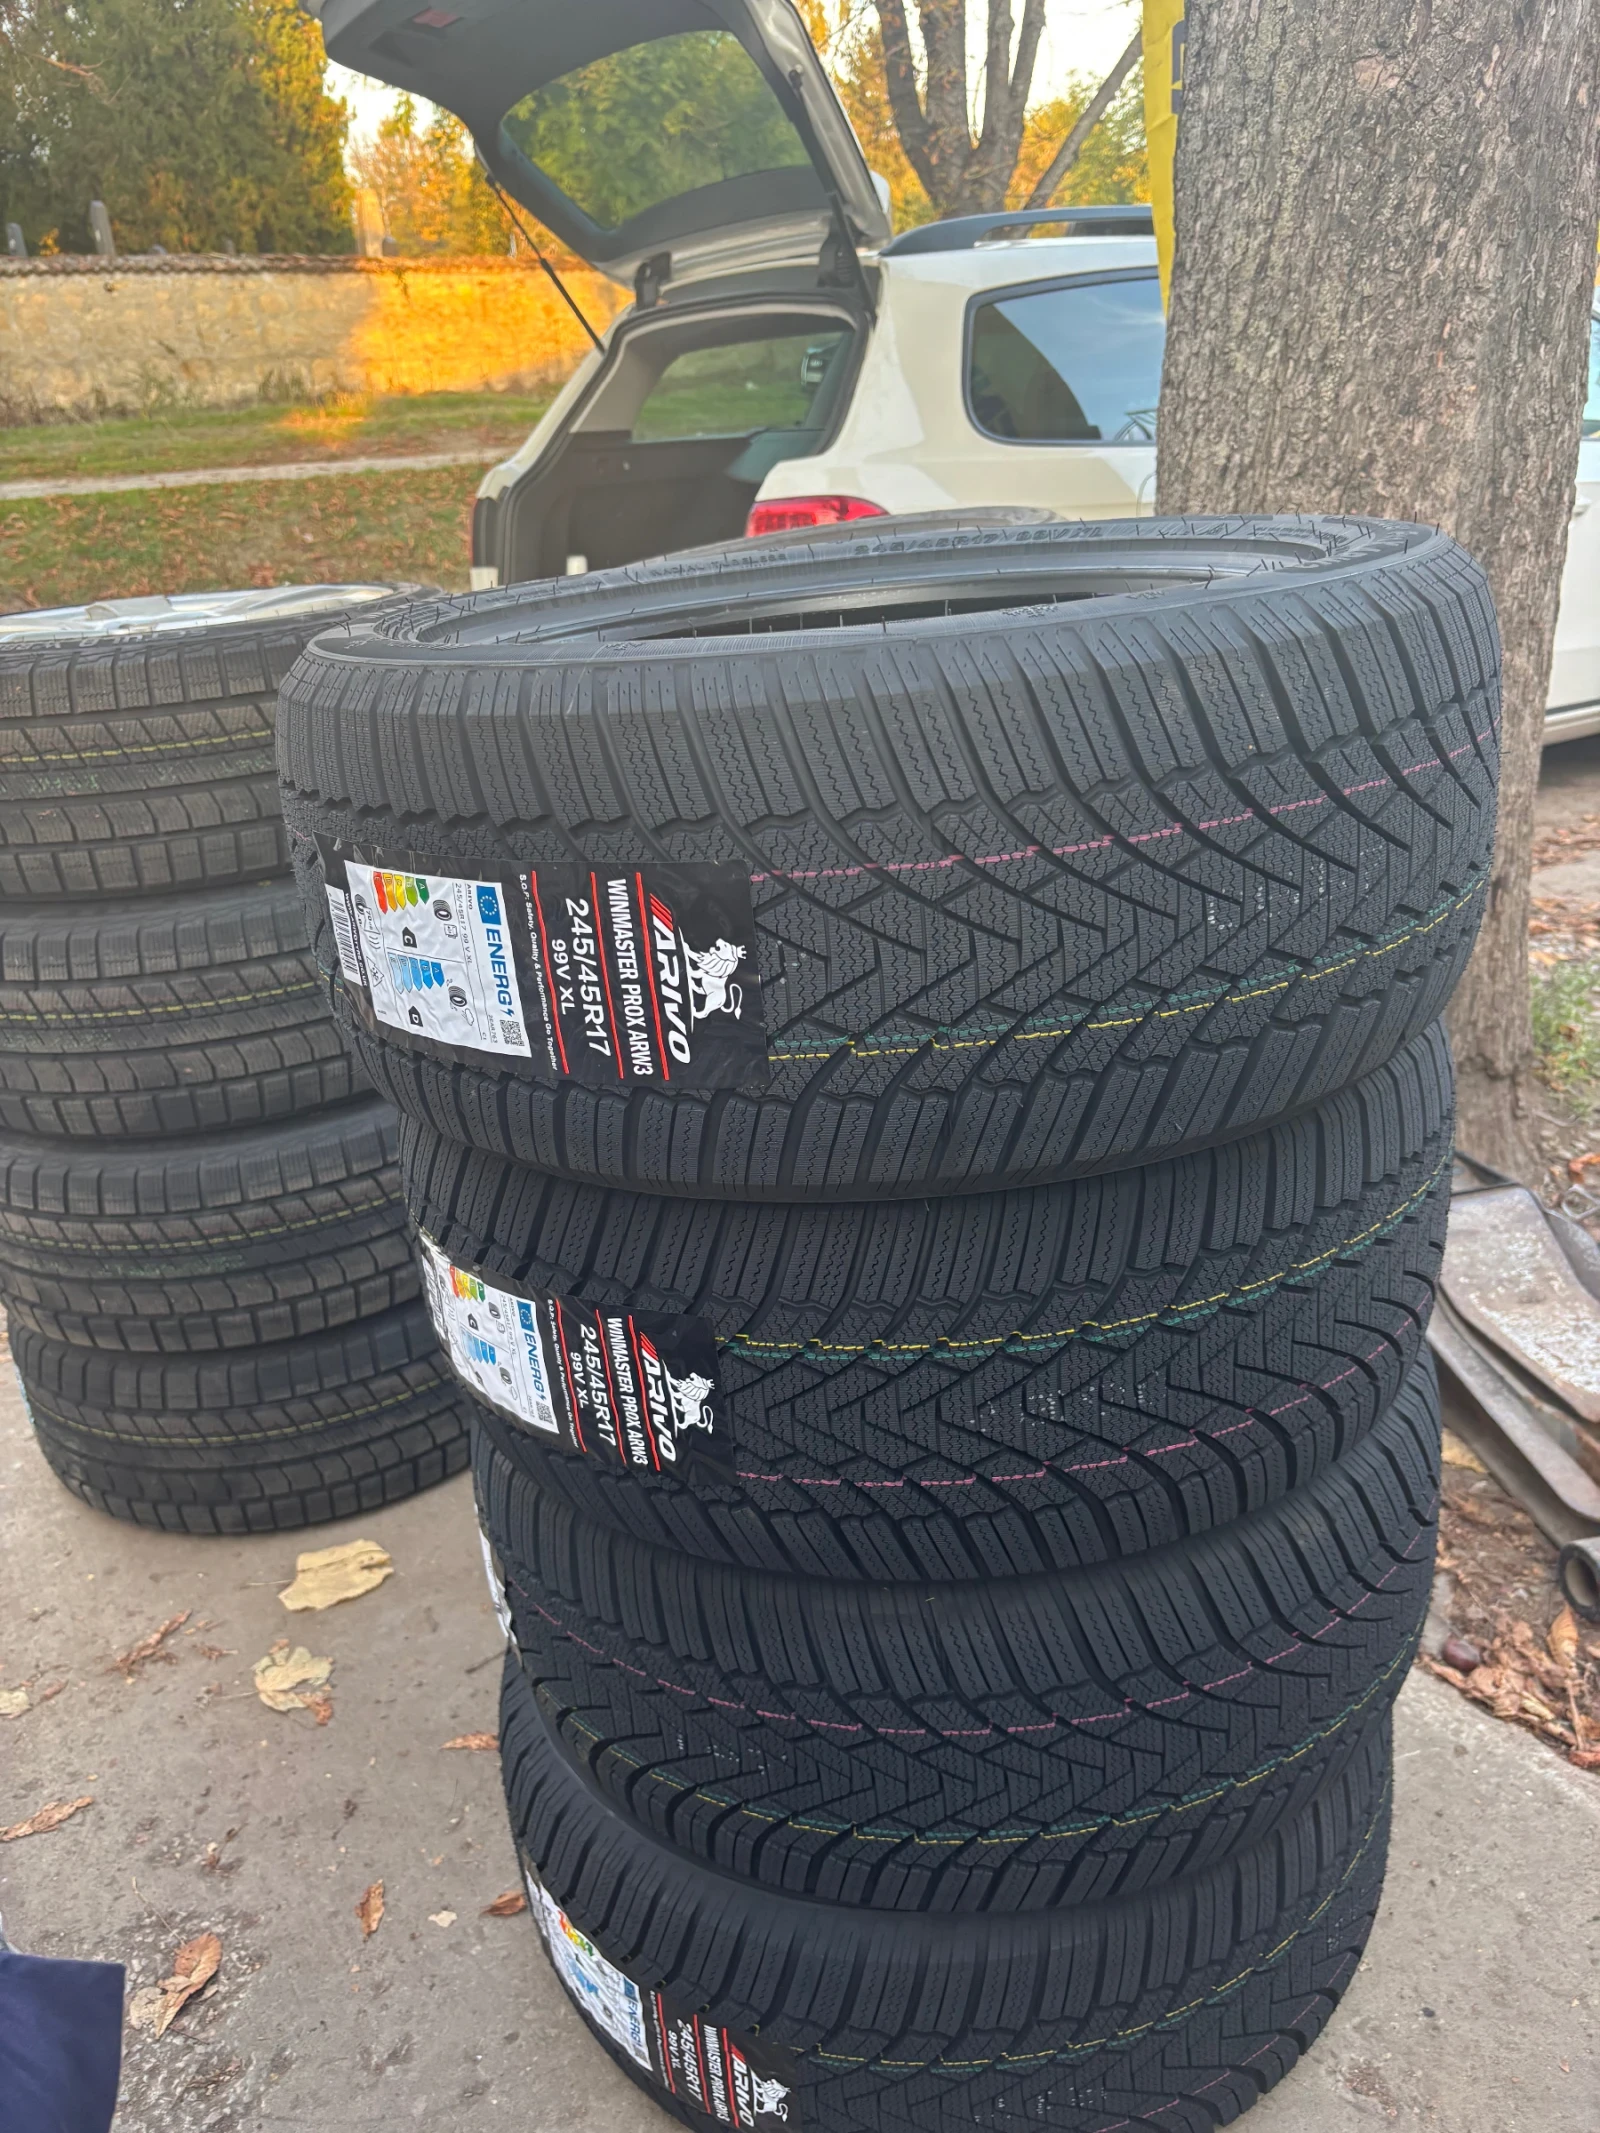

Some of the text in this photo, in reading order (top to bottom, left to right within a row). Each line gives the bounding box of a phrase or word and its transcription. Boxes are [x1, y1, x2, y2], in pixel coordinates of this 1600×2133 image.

[404, 935, 414, 945] C
[526, 902, 535, 930] Safety,
[530, 932, 541, 962] Quality
[535, 971, 549, 1022] Performance
[551, 939, 576, 1015] 99V XL
[565, 898, 611, 1057] 245/45R17
[607, 879, 653, 1076] WINMASTER PROX ARW3
[651, 906, 690, 1064] ARIVO
[412, 1015, 419, 1023] D
[544, 1023, 552, 1035] Go
[546, 1036, 558, 1071] Together
[570, 1352, 589, 1409] 99V XL
[580, 1324, 617, 1446] 245/45R17
[607, 1318, 649, 1465] WINMASTER PROX ARW3
[641, 1343, 676, 1462] ARIVO
[668, 2030, 679, 2056] 99V
[677, 2018, 703, 2101] 245/45R17
[731, 2052, 754, 2127] ARIVO
